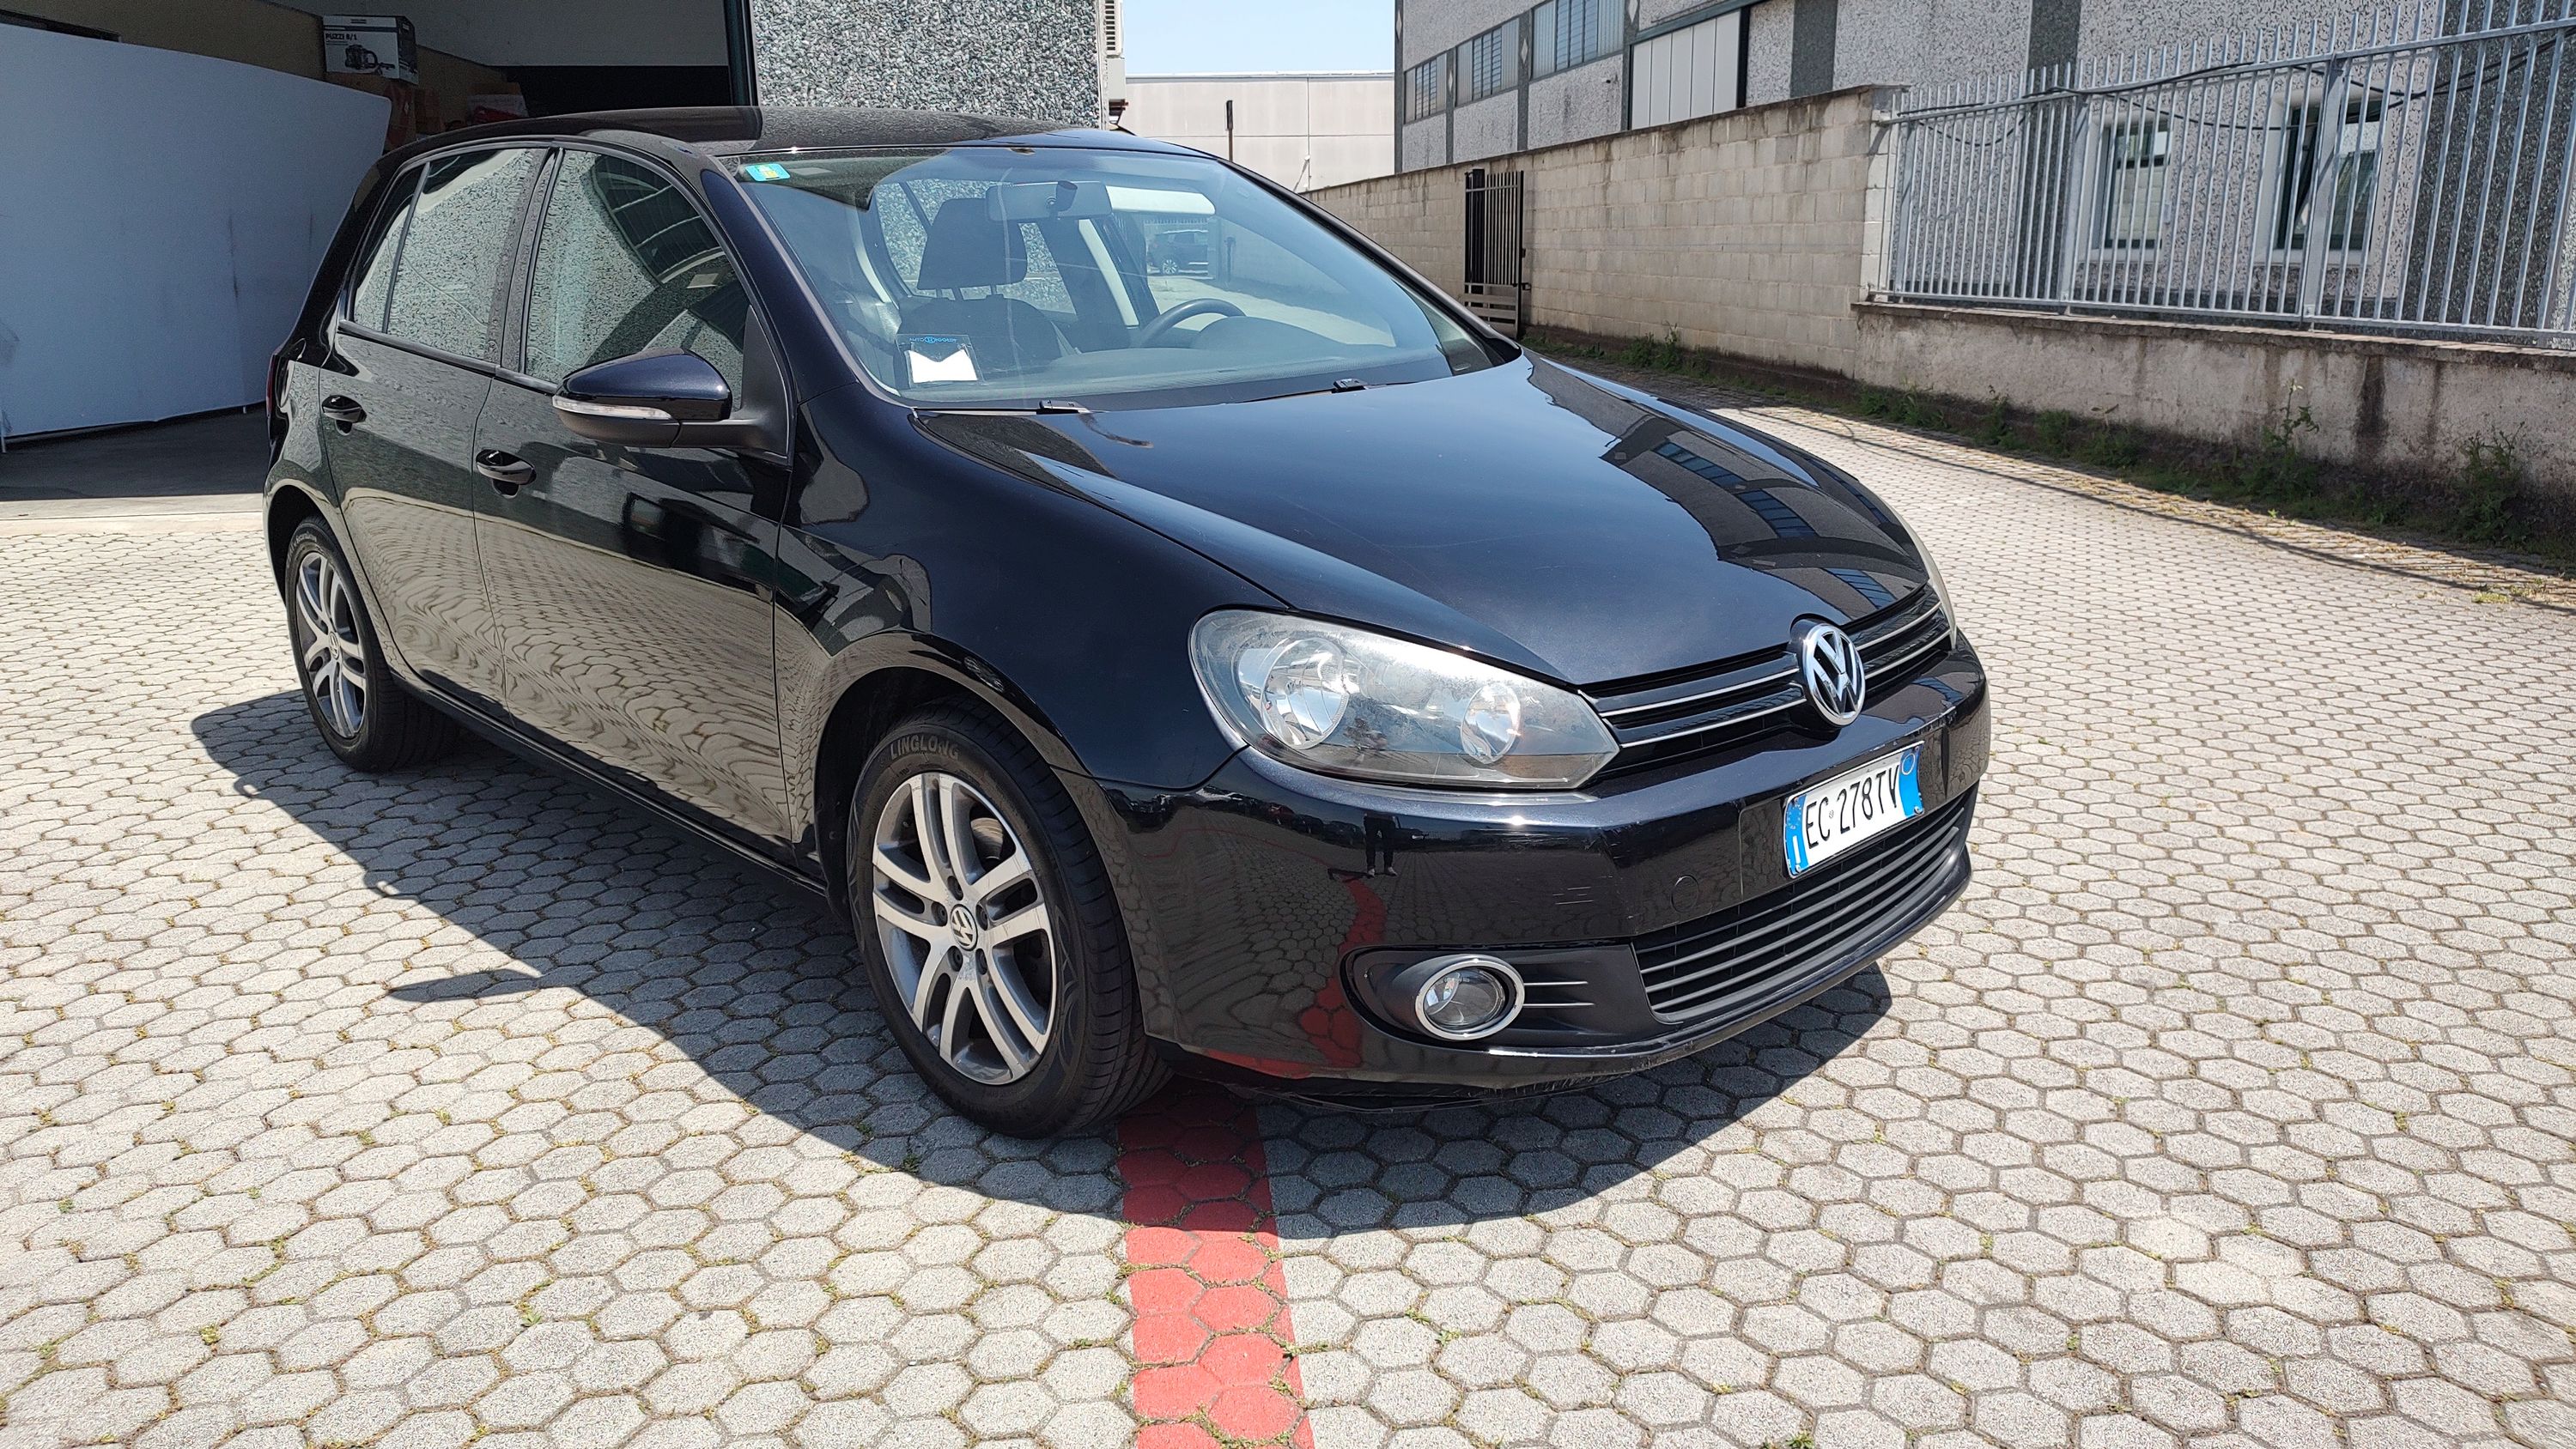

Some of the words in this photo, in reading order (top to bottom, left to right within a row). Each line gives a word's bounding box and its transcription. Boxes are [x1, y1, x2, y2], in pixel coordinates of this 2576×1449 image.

[890, 734, 959, 761] LINGLONG
[1806, 797, 1831, 849] EC
[1837, 765, 1899, 834] 278TV
